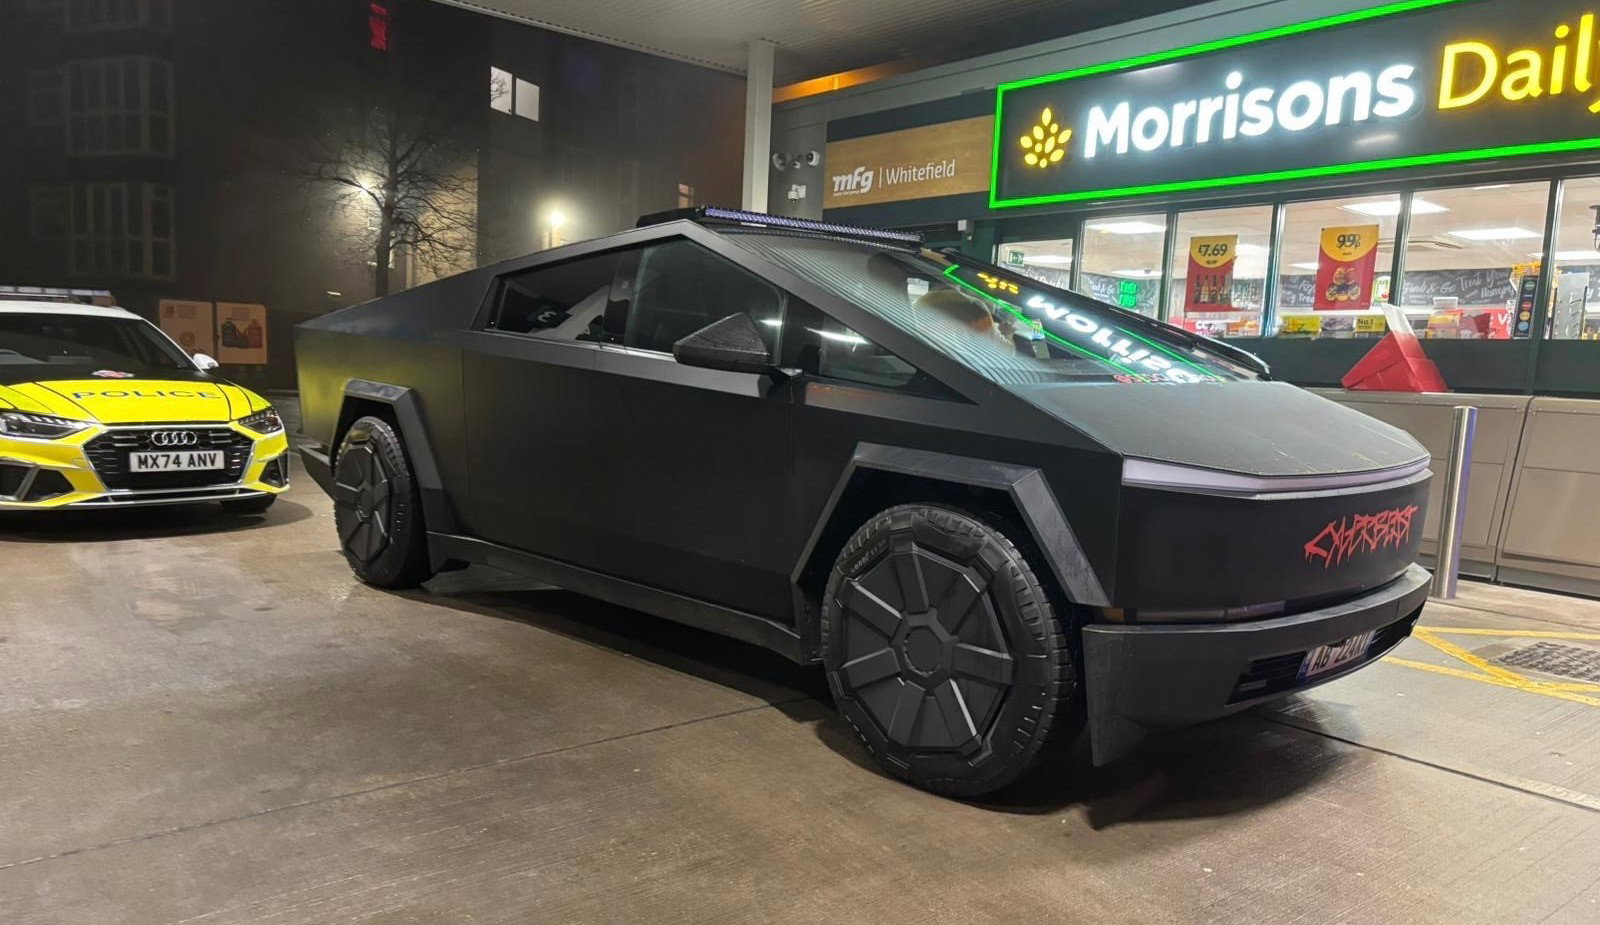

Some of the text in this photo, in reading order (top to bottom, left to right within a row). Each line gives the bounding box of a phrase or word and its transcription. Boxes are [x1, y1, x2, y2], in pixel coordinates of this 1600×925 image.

[1084, 14, 1600, 158] Morrisons Dail
[832, 159, 956, 194] mfg Whitefield
[1197, 243, 1228, 257] £7.69
[72, 389, 222, 400] POLICE
[137, 452, 217, 470] MX74 ANV
